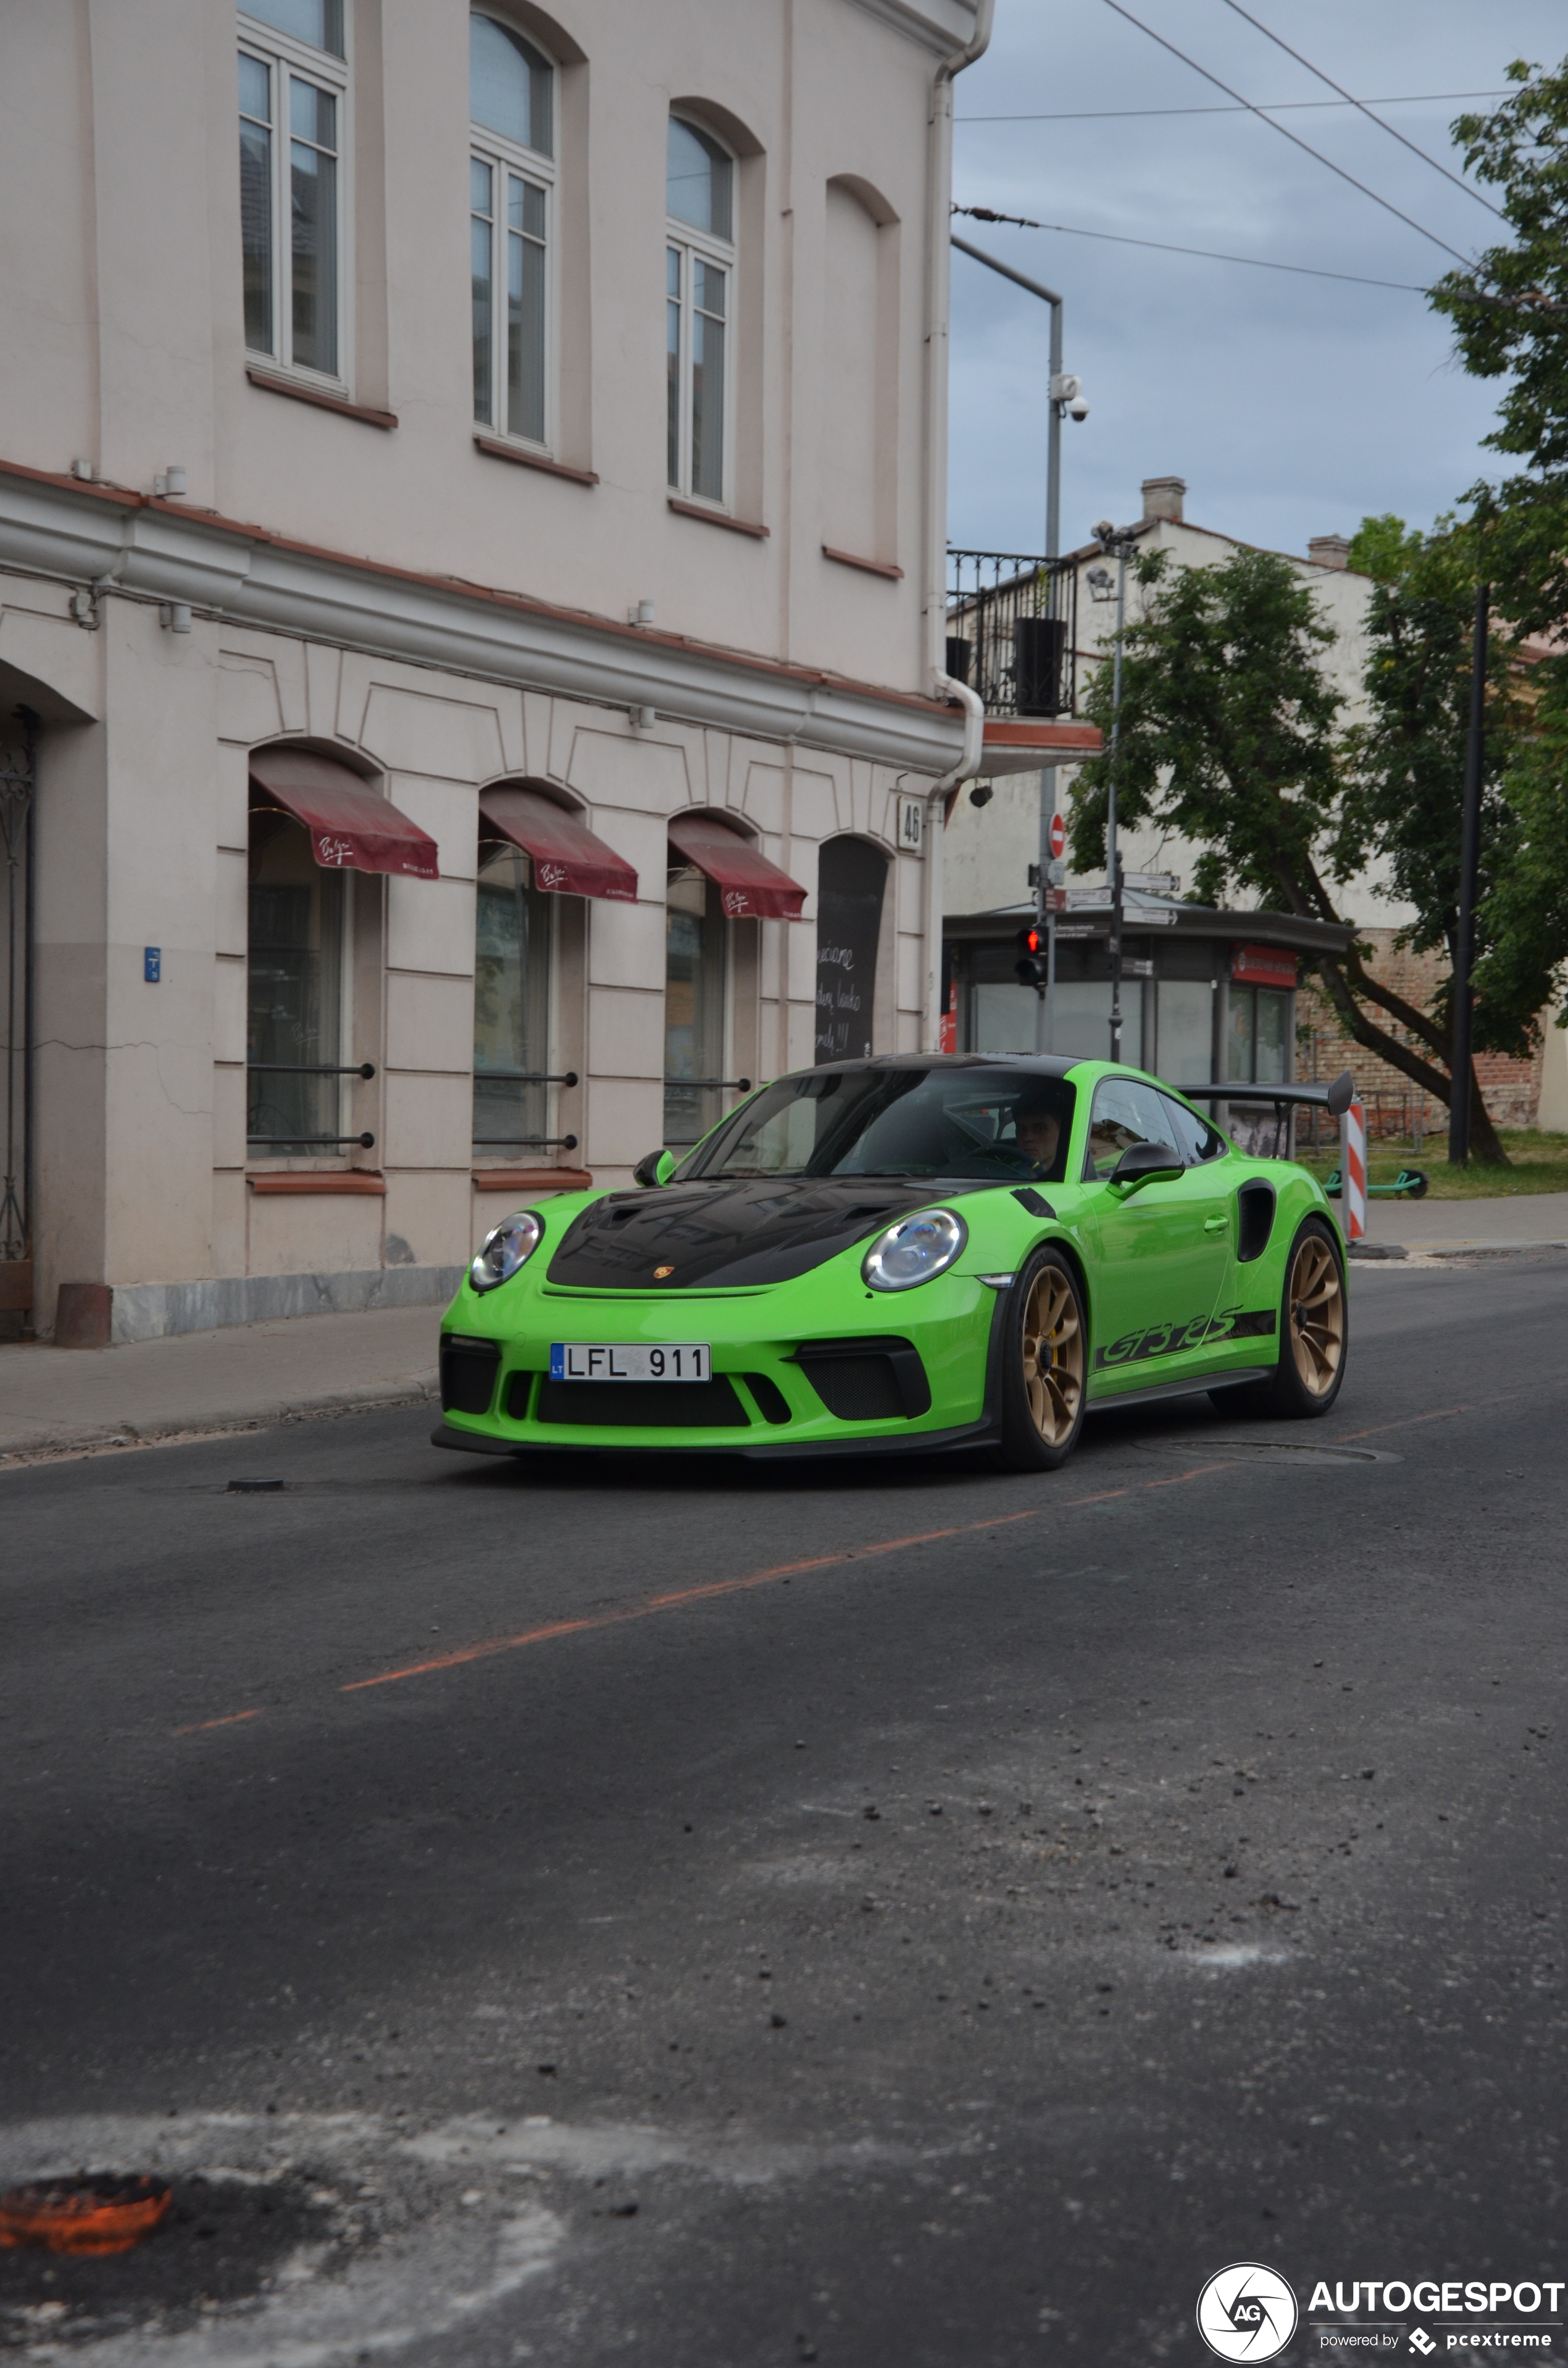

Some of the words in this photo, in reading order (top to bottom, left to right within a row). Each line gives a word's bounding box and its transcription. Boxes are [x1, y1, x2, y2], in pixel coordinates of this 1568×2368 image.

[905, 805, 919, 842] 46
[1103, 1322, 1176, 1362] GT3
[1176, 1304, 1244, 1347] RS
[552, 1365, 564, 1374] LT
[568, 1348, 627, 1376] LFL
[649, 1349, 701, 1377] 911
